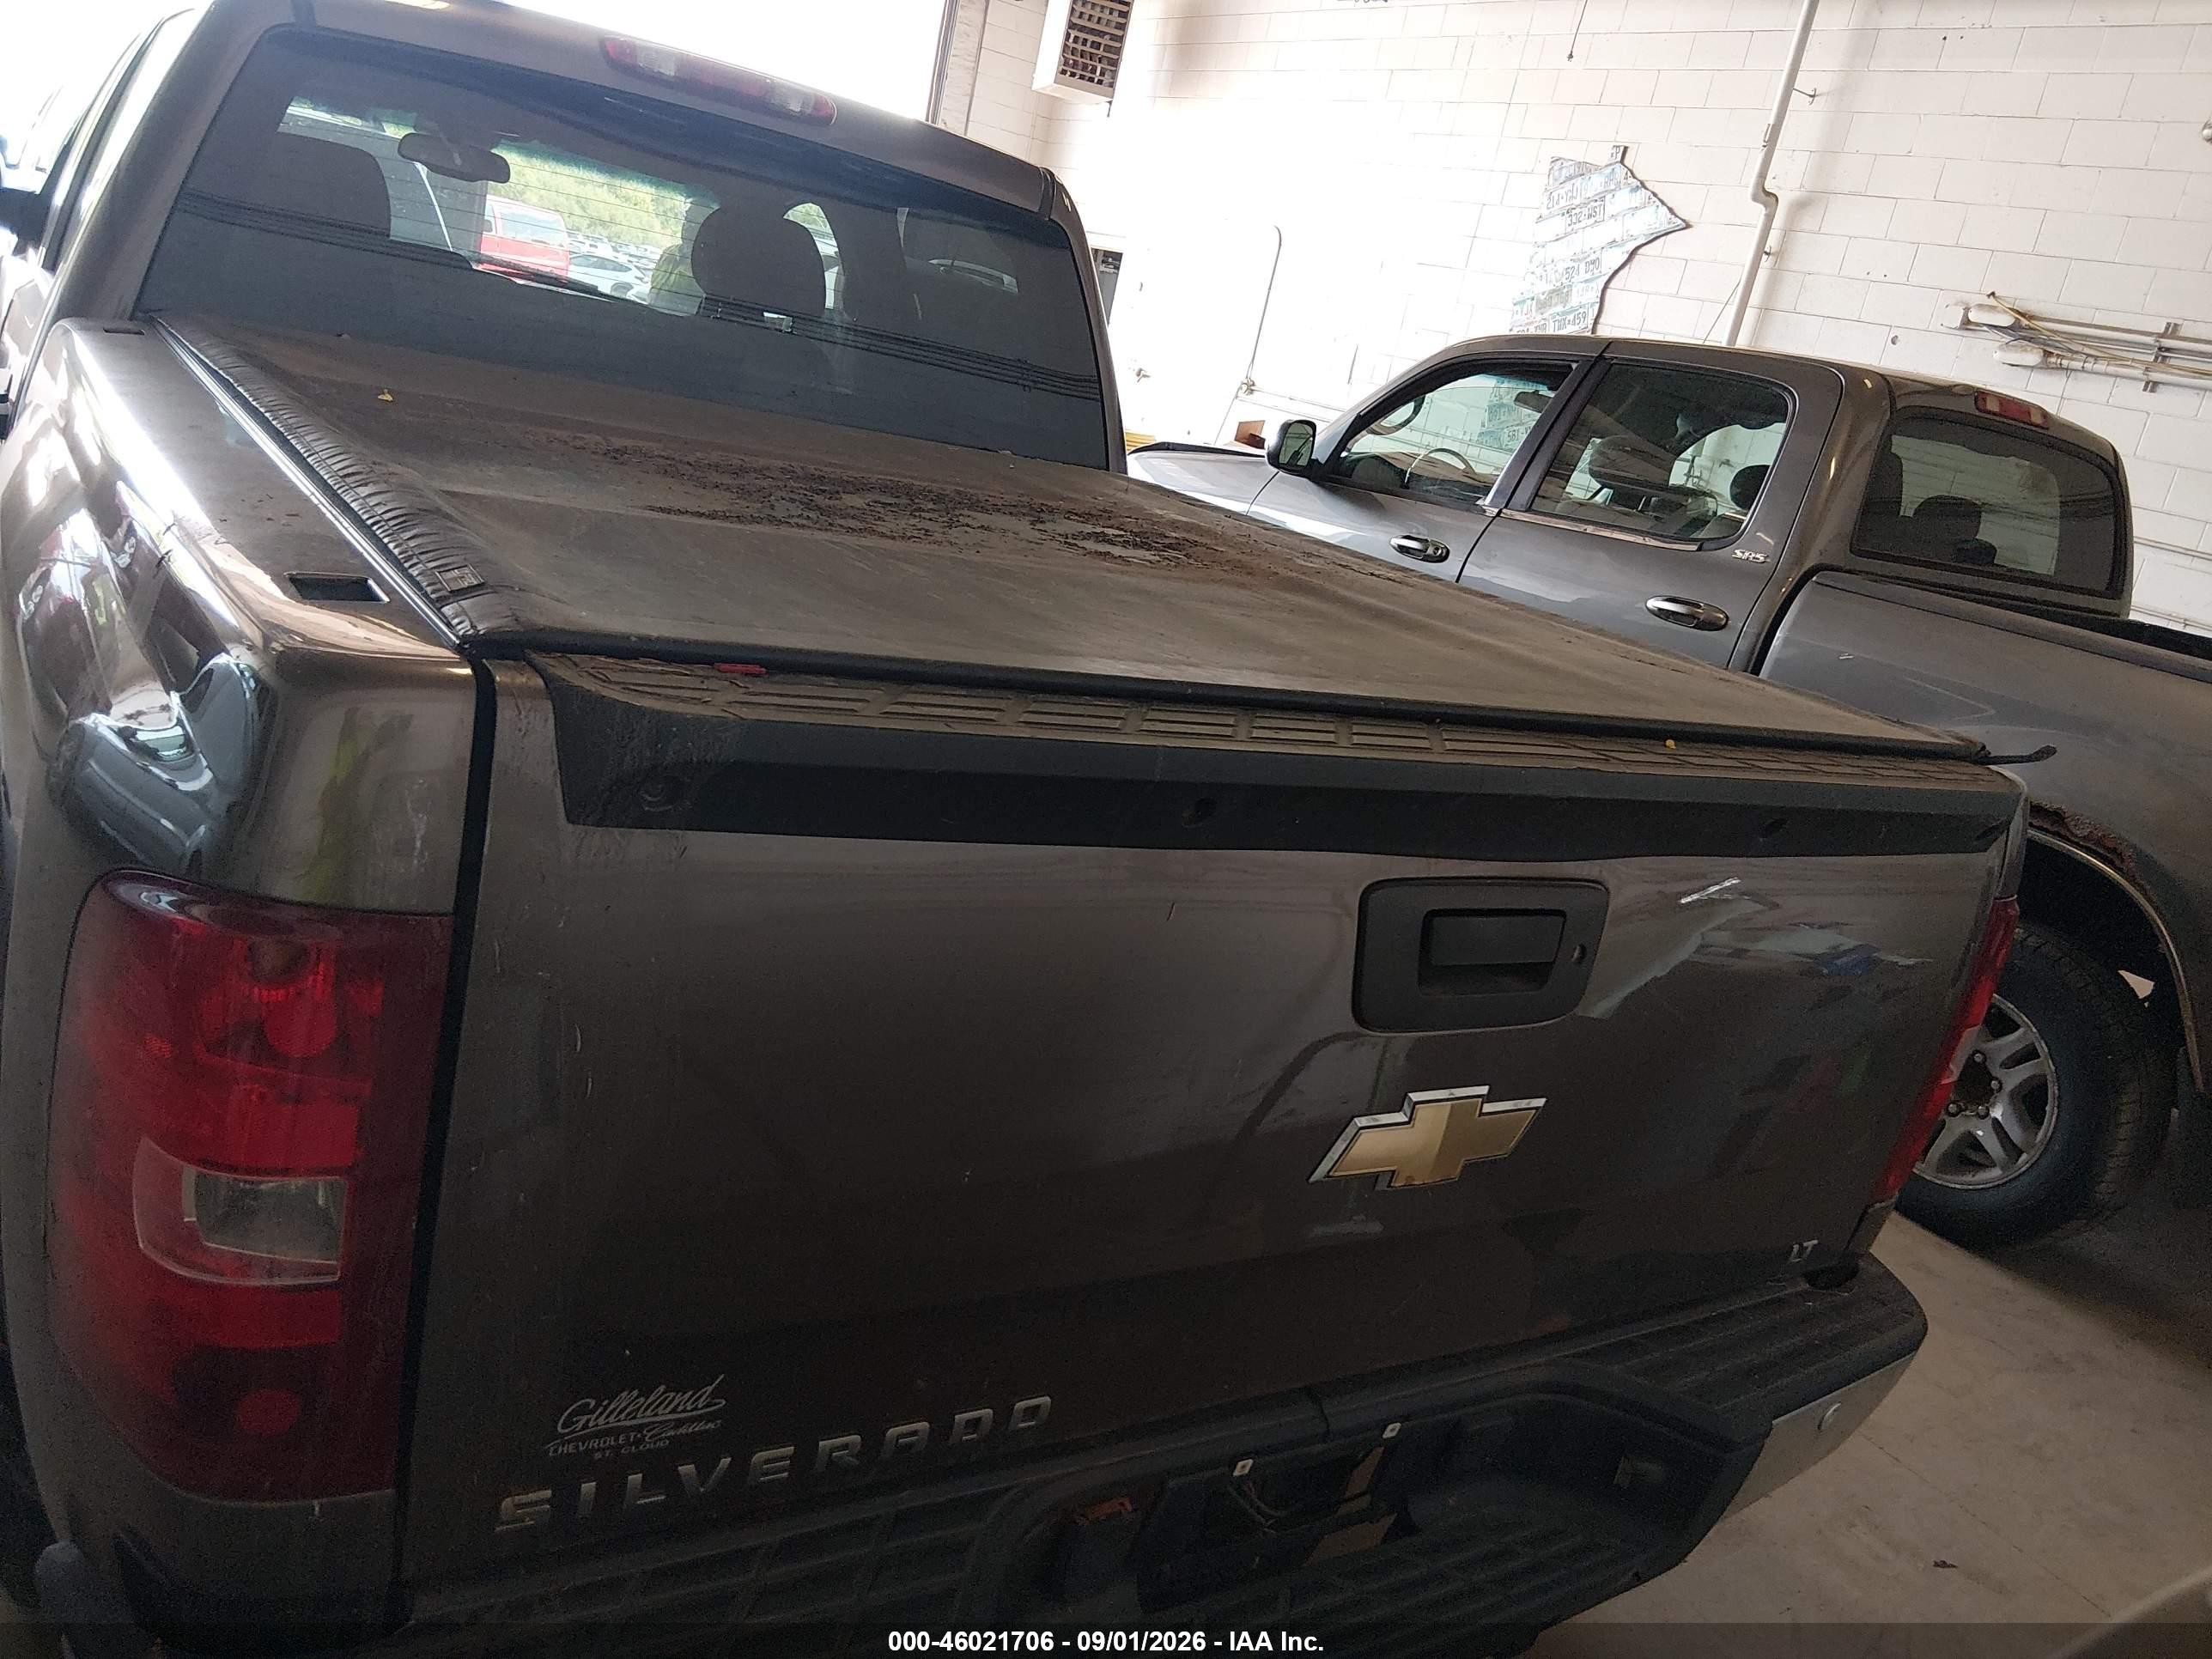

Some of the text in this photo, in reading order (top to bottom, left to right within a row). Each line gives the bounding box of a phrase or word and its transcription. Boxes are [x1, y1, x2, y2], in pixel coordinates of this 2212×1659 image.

[1787, 1239, 1819, 1264] LT
[556, 1373, 726, 1436] Gilleland
[495, 1394, 1053, 1534] SILVERADO
